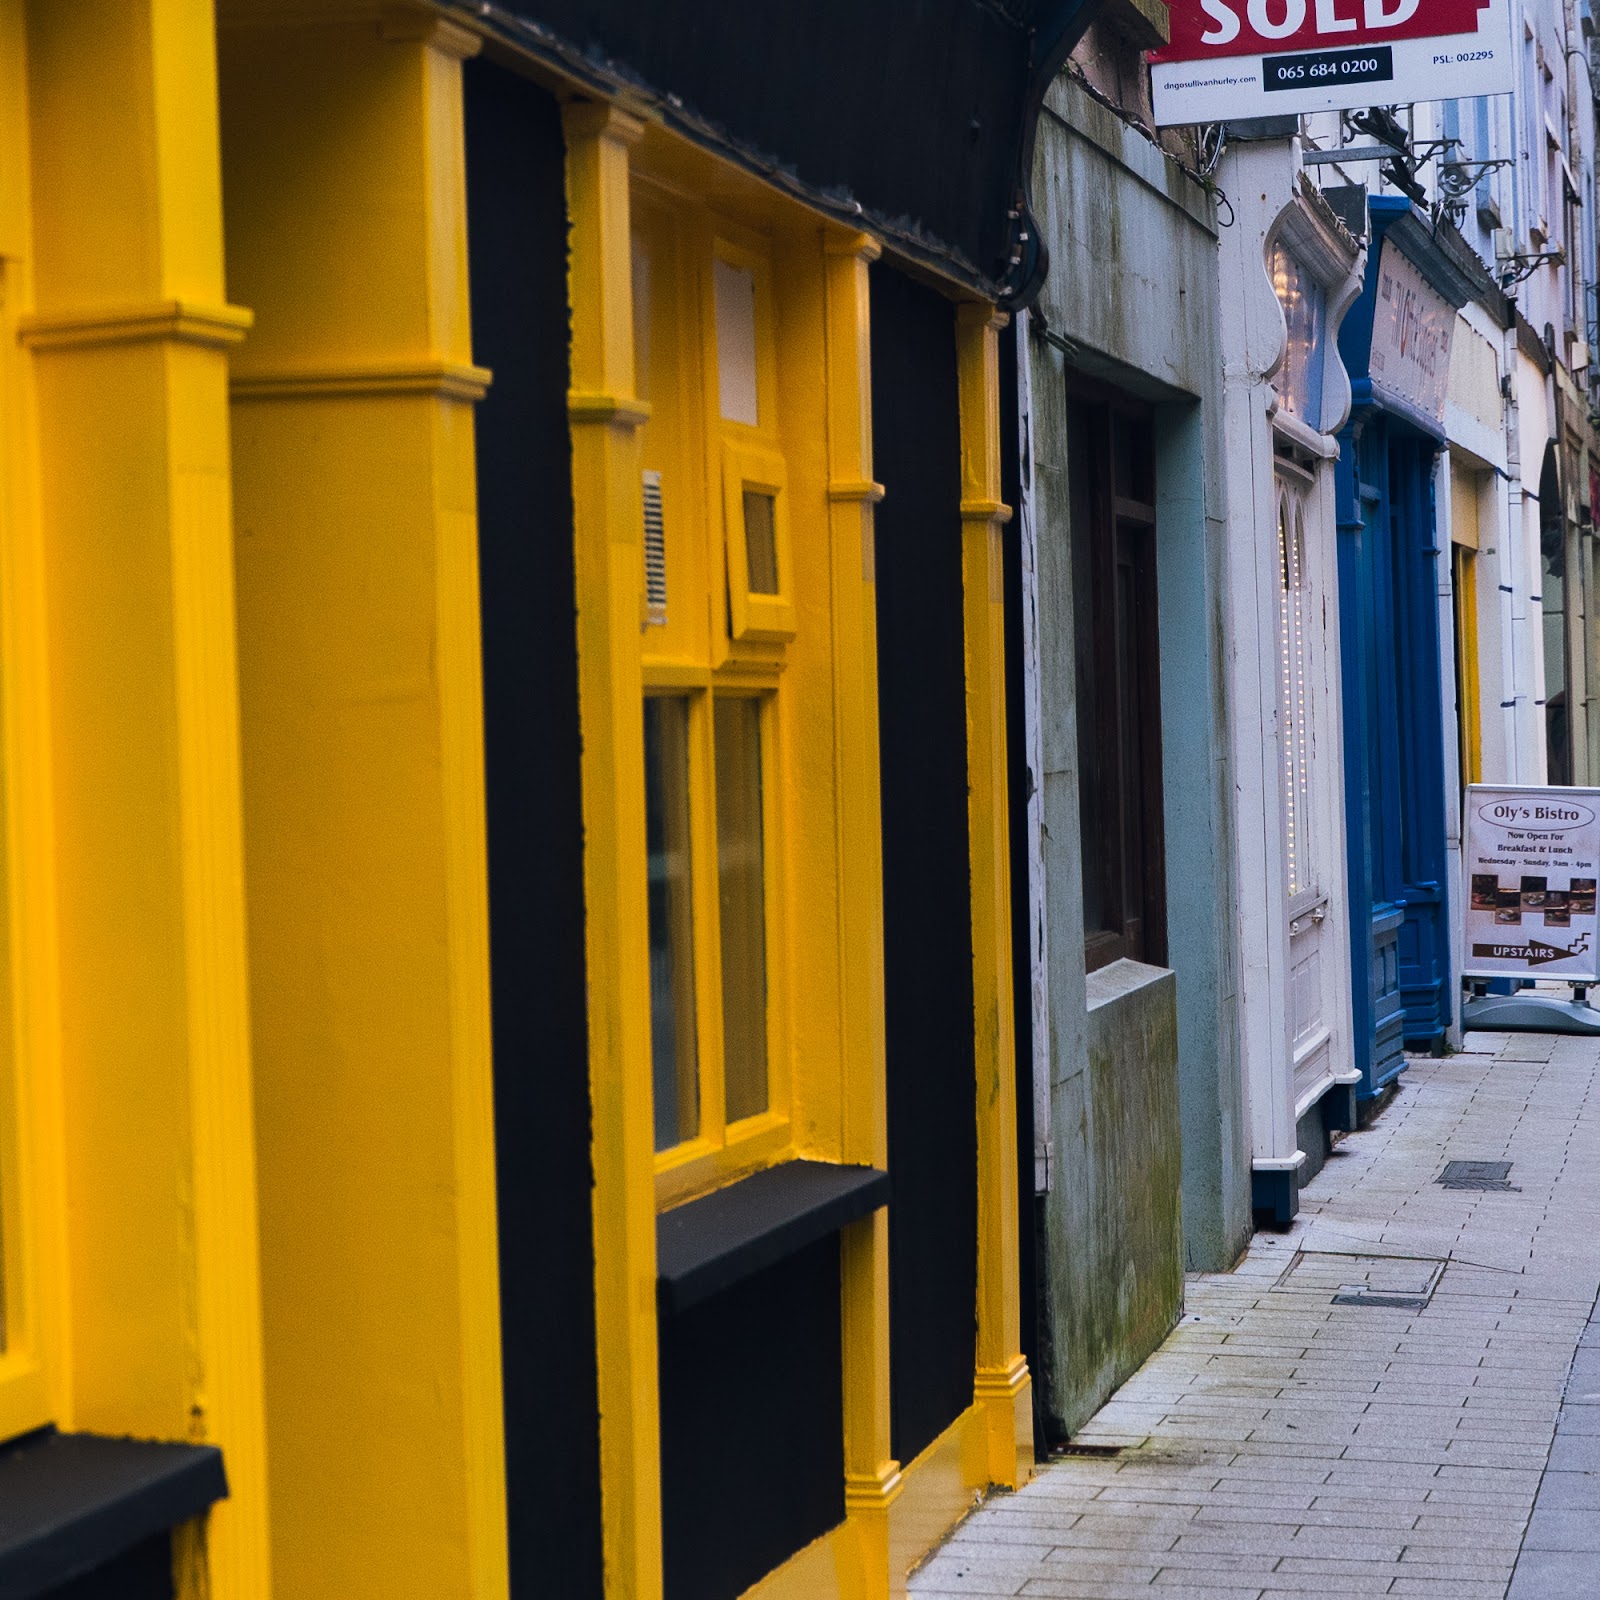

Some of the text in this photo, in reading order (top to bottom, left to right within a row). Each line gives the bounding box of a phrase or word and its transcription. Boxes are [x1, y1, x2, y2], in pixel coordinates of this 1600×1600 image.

[1432, 50, 1495, 65] PSL: 002295
[1277, 58, 1379, 80] 065 684 0200
[1163, 74, 1258, 91] dngosullivanhurley.com
[1494, 805, 1580, 822] Oly's Bistro
[1507, 831, 1564, 841] Now Open For
[1497, 844, 1536, 853] Breakfast
[1548, 846, 1573, 854] Lunch
[1478, 857, 1517, 867] Wednesday
[1493, 947, 1555, 958] UPSTAIRS
